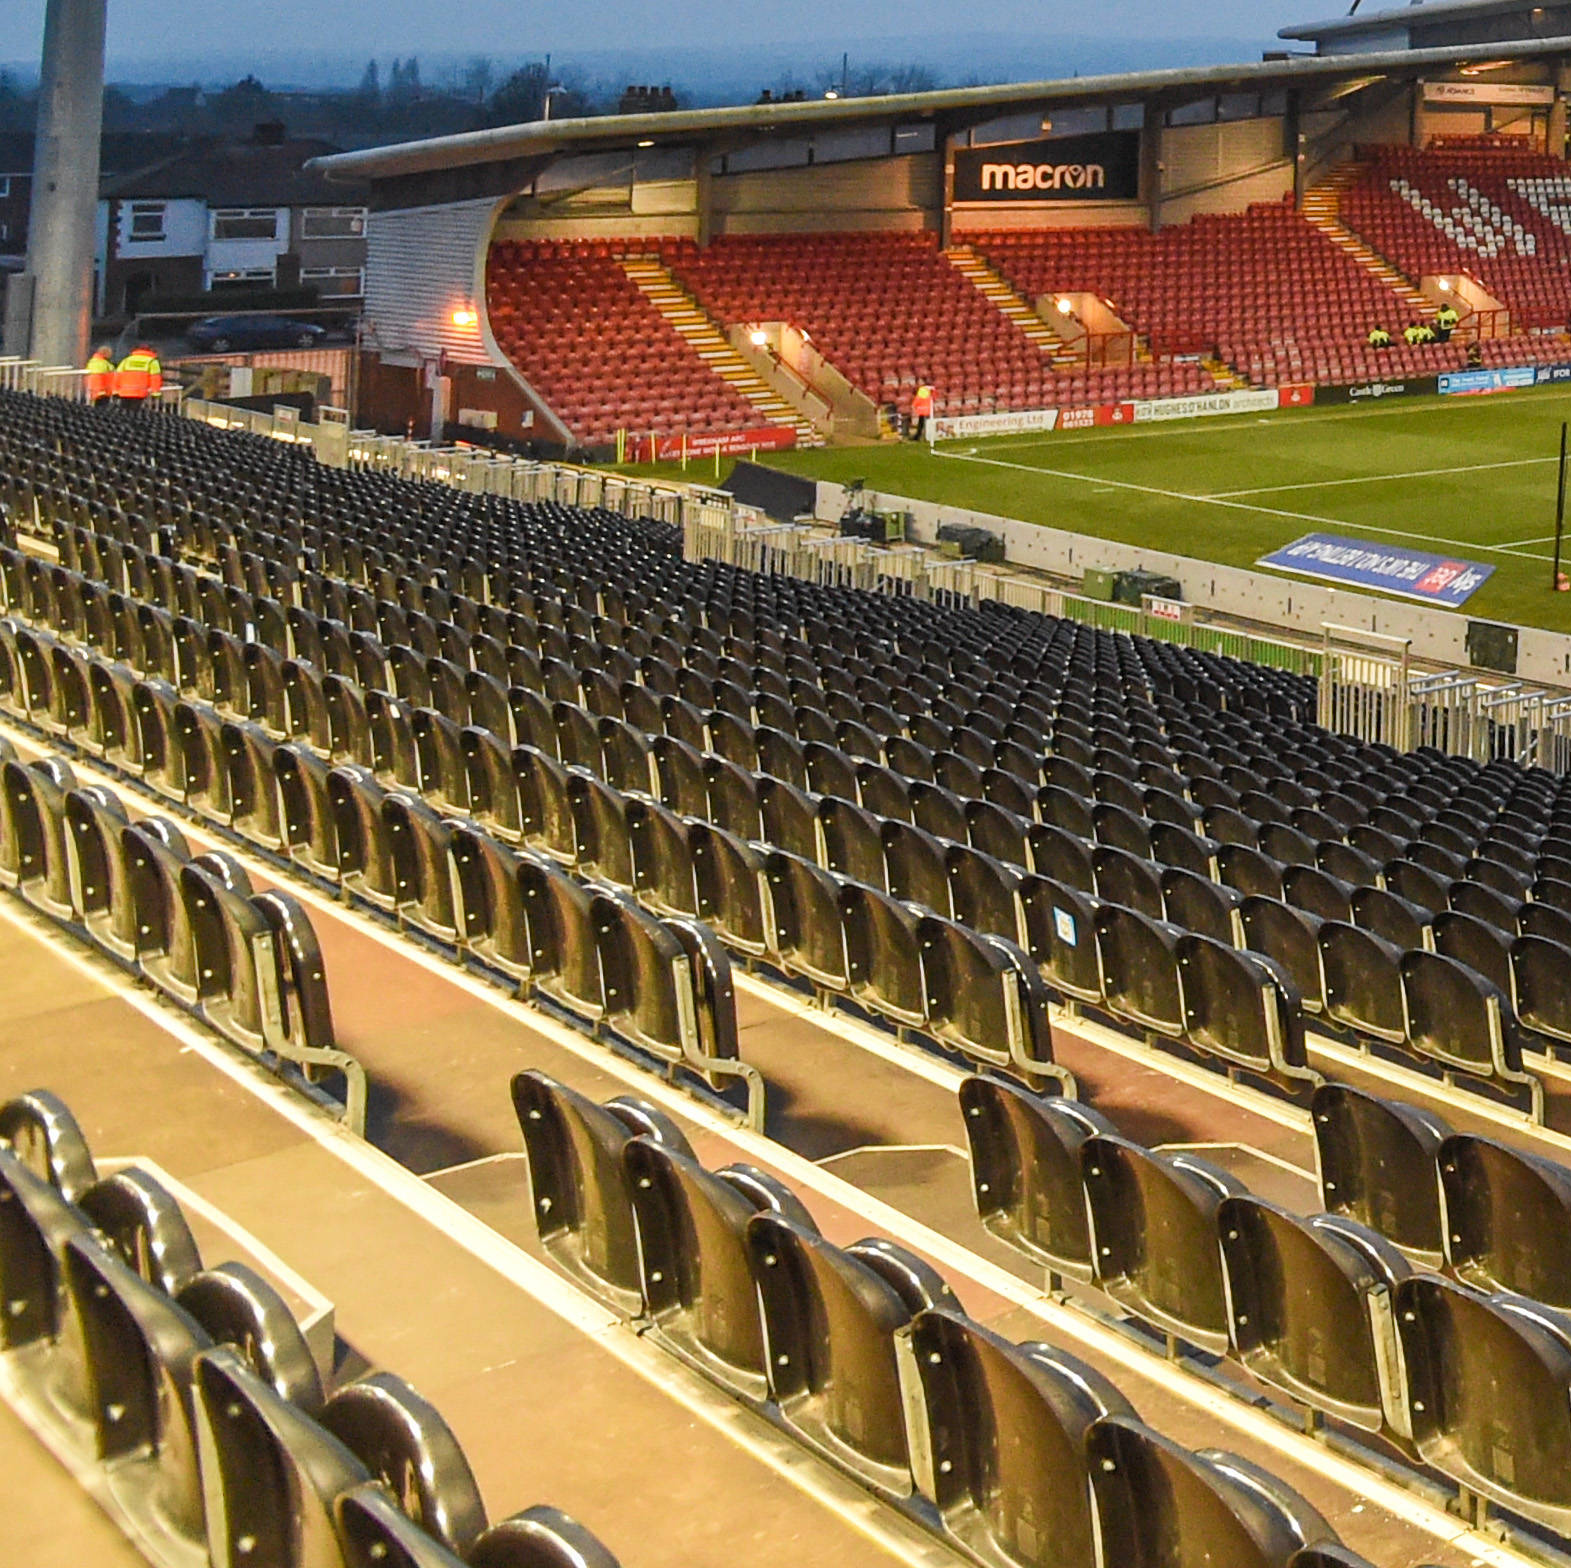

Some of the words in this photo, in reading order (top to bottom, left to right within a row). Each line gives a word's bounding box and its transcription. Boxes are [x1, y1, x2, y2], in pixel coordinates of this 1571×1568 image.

[981, 163, 1104, 190] macron
[958, 416, 1025, 429] Engineering
[1026, 413, 1044, 425] Ltd
